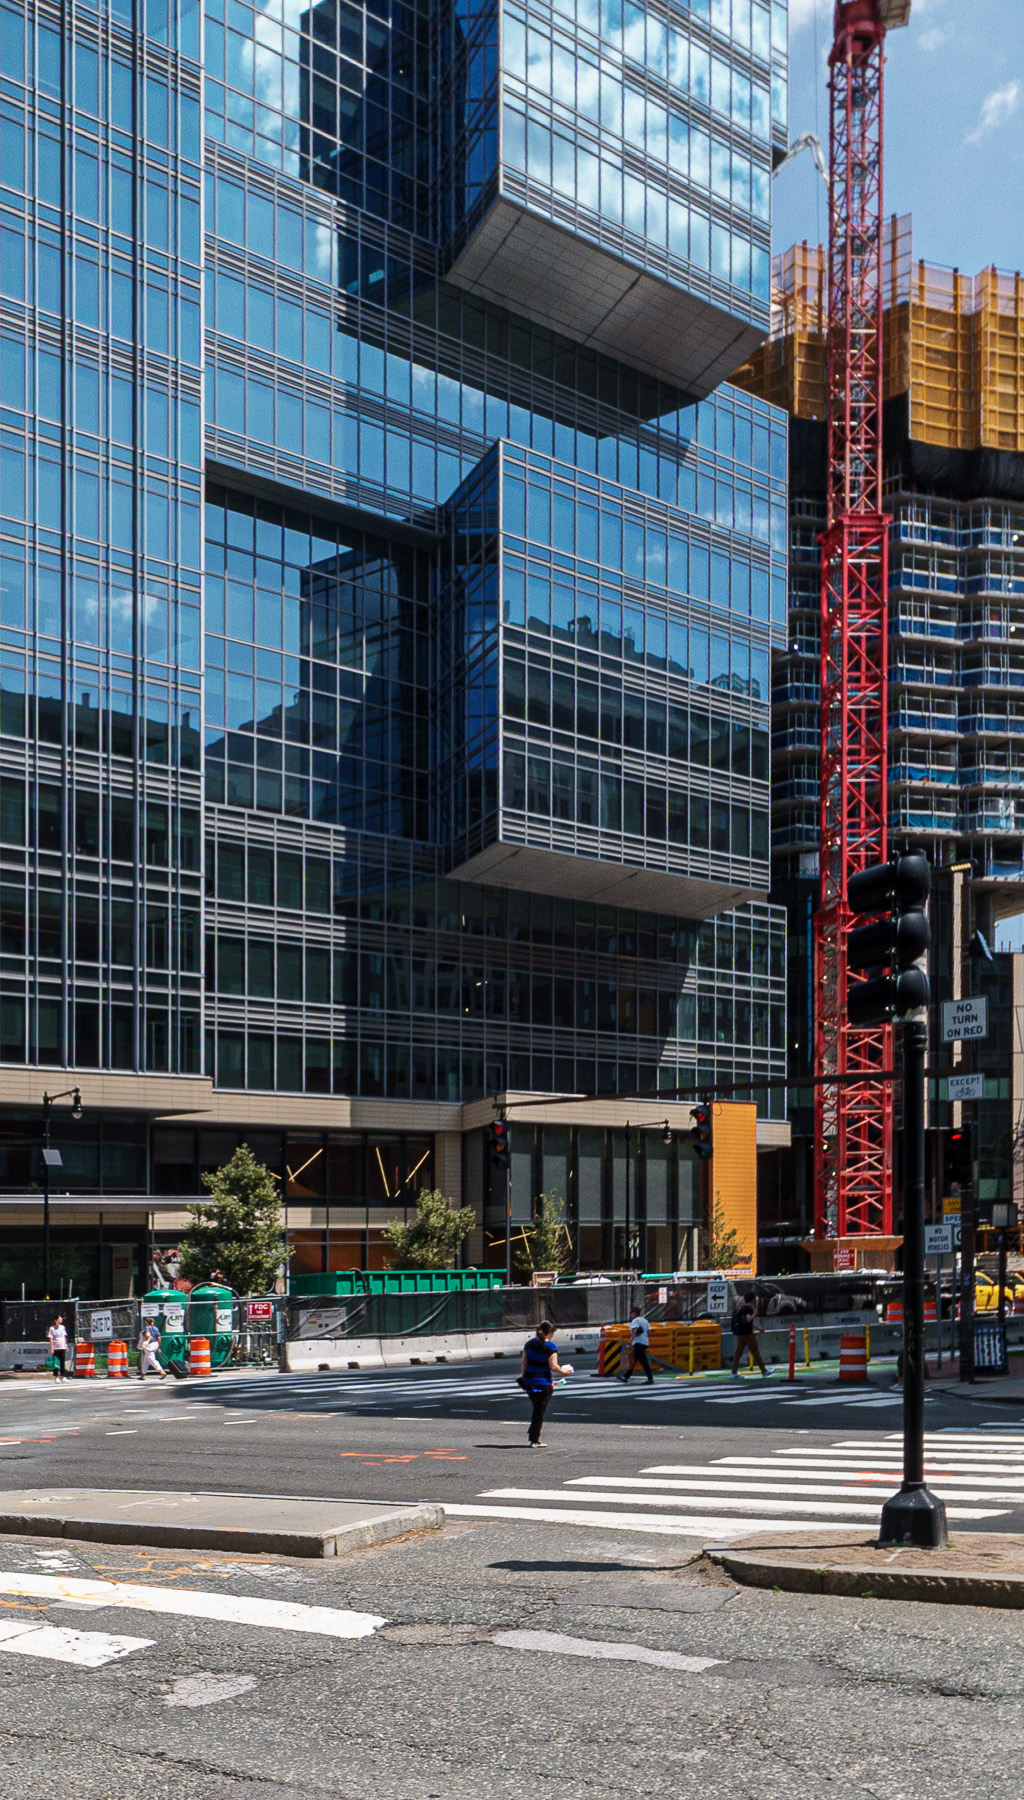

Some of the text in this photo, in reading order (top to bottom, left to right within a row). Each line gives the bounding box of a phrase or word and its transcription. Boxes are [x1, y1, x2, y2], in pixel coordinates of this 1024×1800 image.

[956, 1003, 973, 1013] NO
[952, 1014, 978, 1025] TURN
[947, 1026, 983, 1037] ON RED
[950, 1076, 980, 1086] EXCEPT
